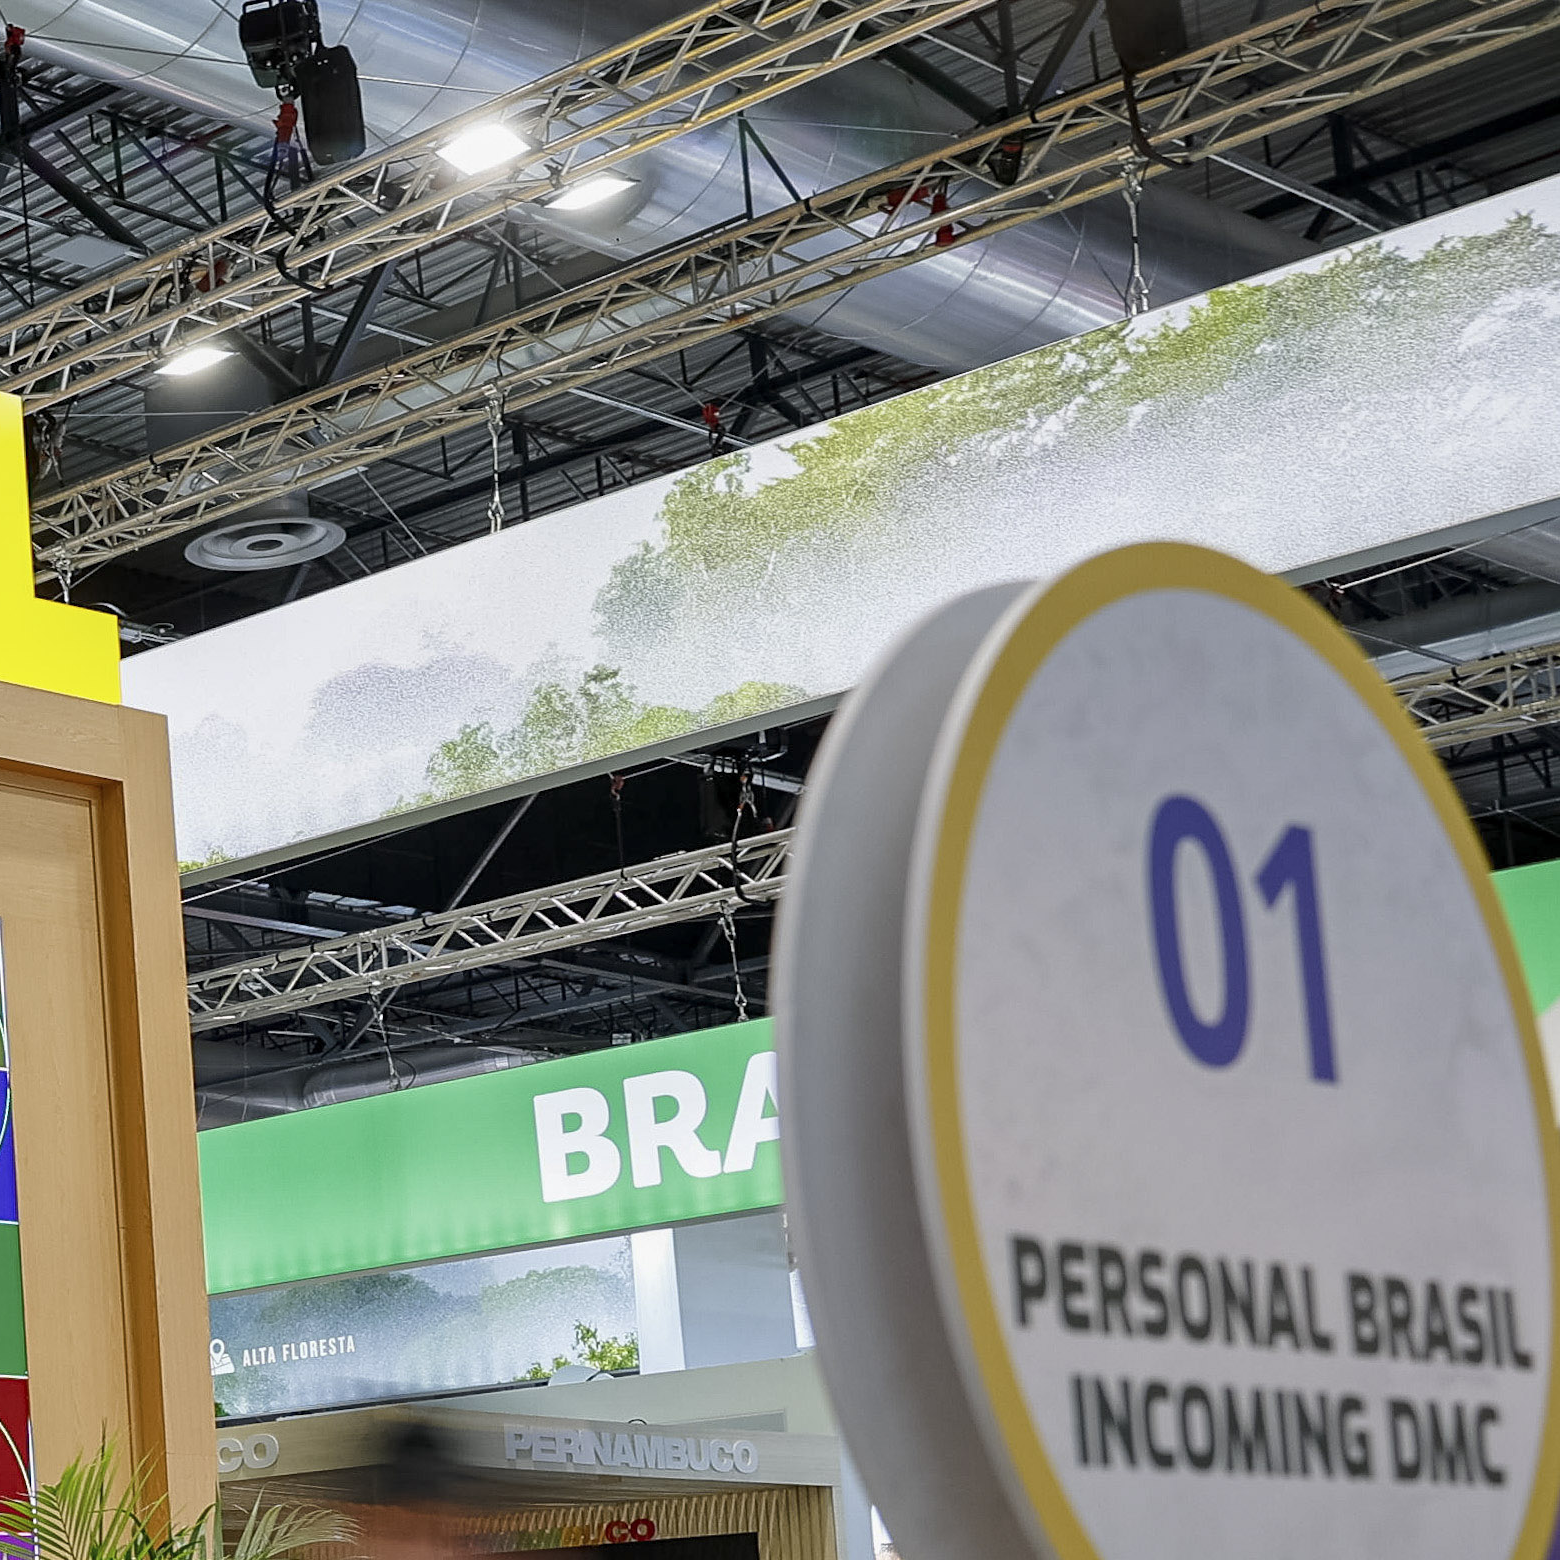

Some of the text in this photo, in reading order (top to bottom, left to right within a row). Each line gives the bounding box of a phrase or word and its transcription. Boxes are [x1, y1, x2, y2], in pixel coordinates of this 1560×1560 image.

[1145, 794, 1340, 1086] 01
[243, 1335, 356, 1367] ALTA FLORESTA
[1008, 1234, 1533, 1370] PERSONAL BRASIL
[504, 1424, 759, 1474] PERNAMBUCO
[1071, 1373, 1508, 1488] INCOMING DMC
